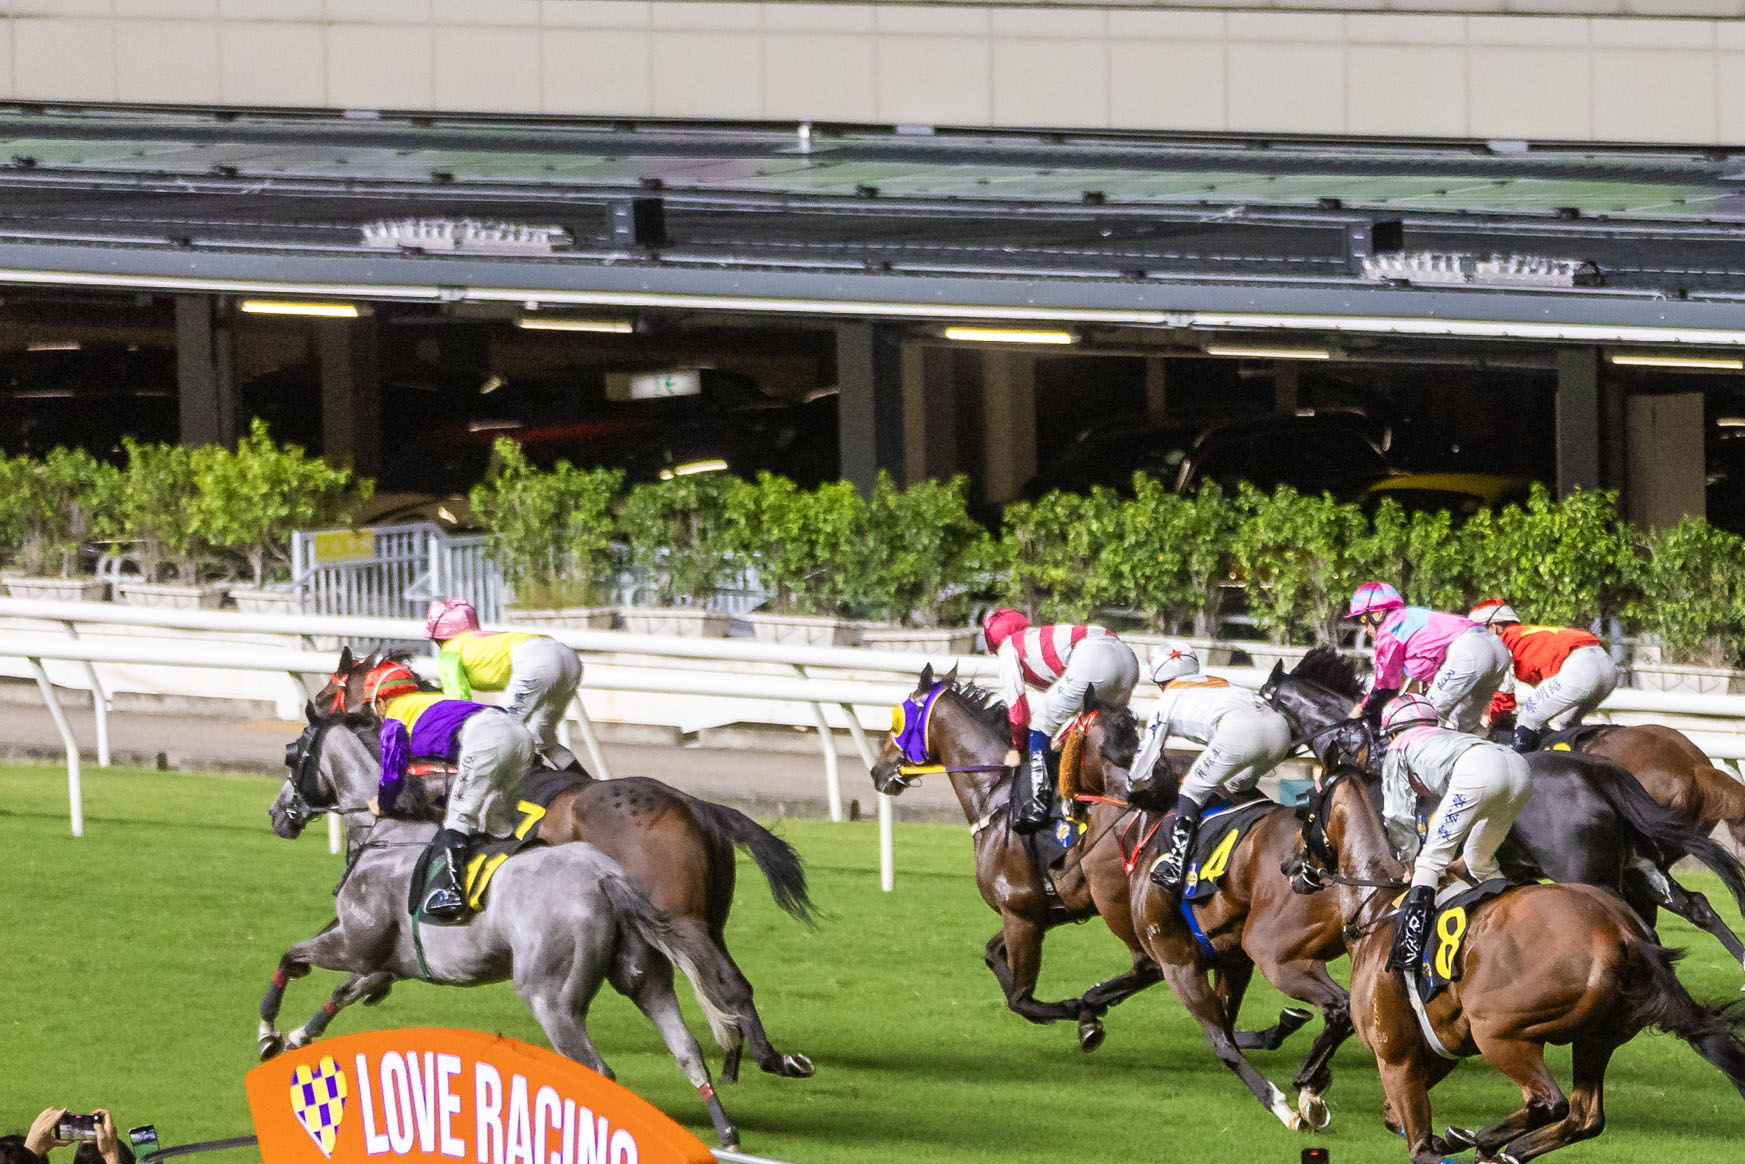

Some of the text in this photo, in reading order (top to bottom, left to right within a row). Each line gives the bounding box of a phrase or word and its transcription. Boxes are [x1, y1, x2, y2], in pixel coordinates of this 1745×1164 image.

[515, 799, 546, 841] 7
[465, 853, 509, 911] 11
[1200, 829, 1240, 883] 4
[1435, 906, 1467, 980] 8
[355, 1051, 465, 1158] LOVE
